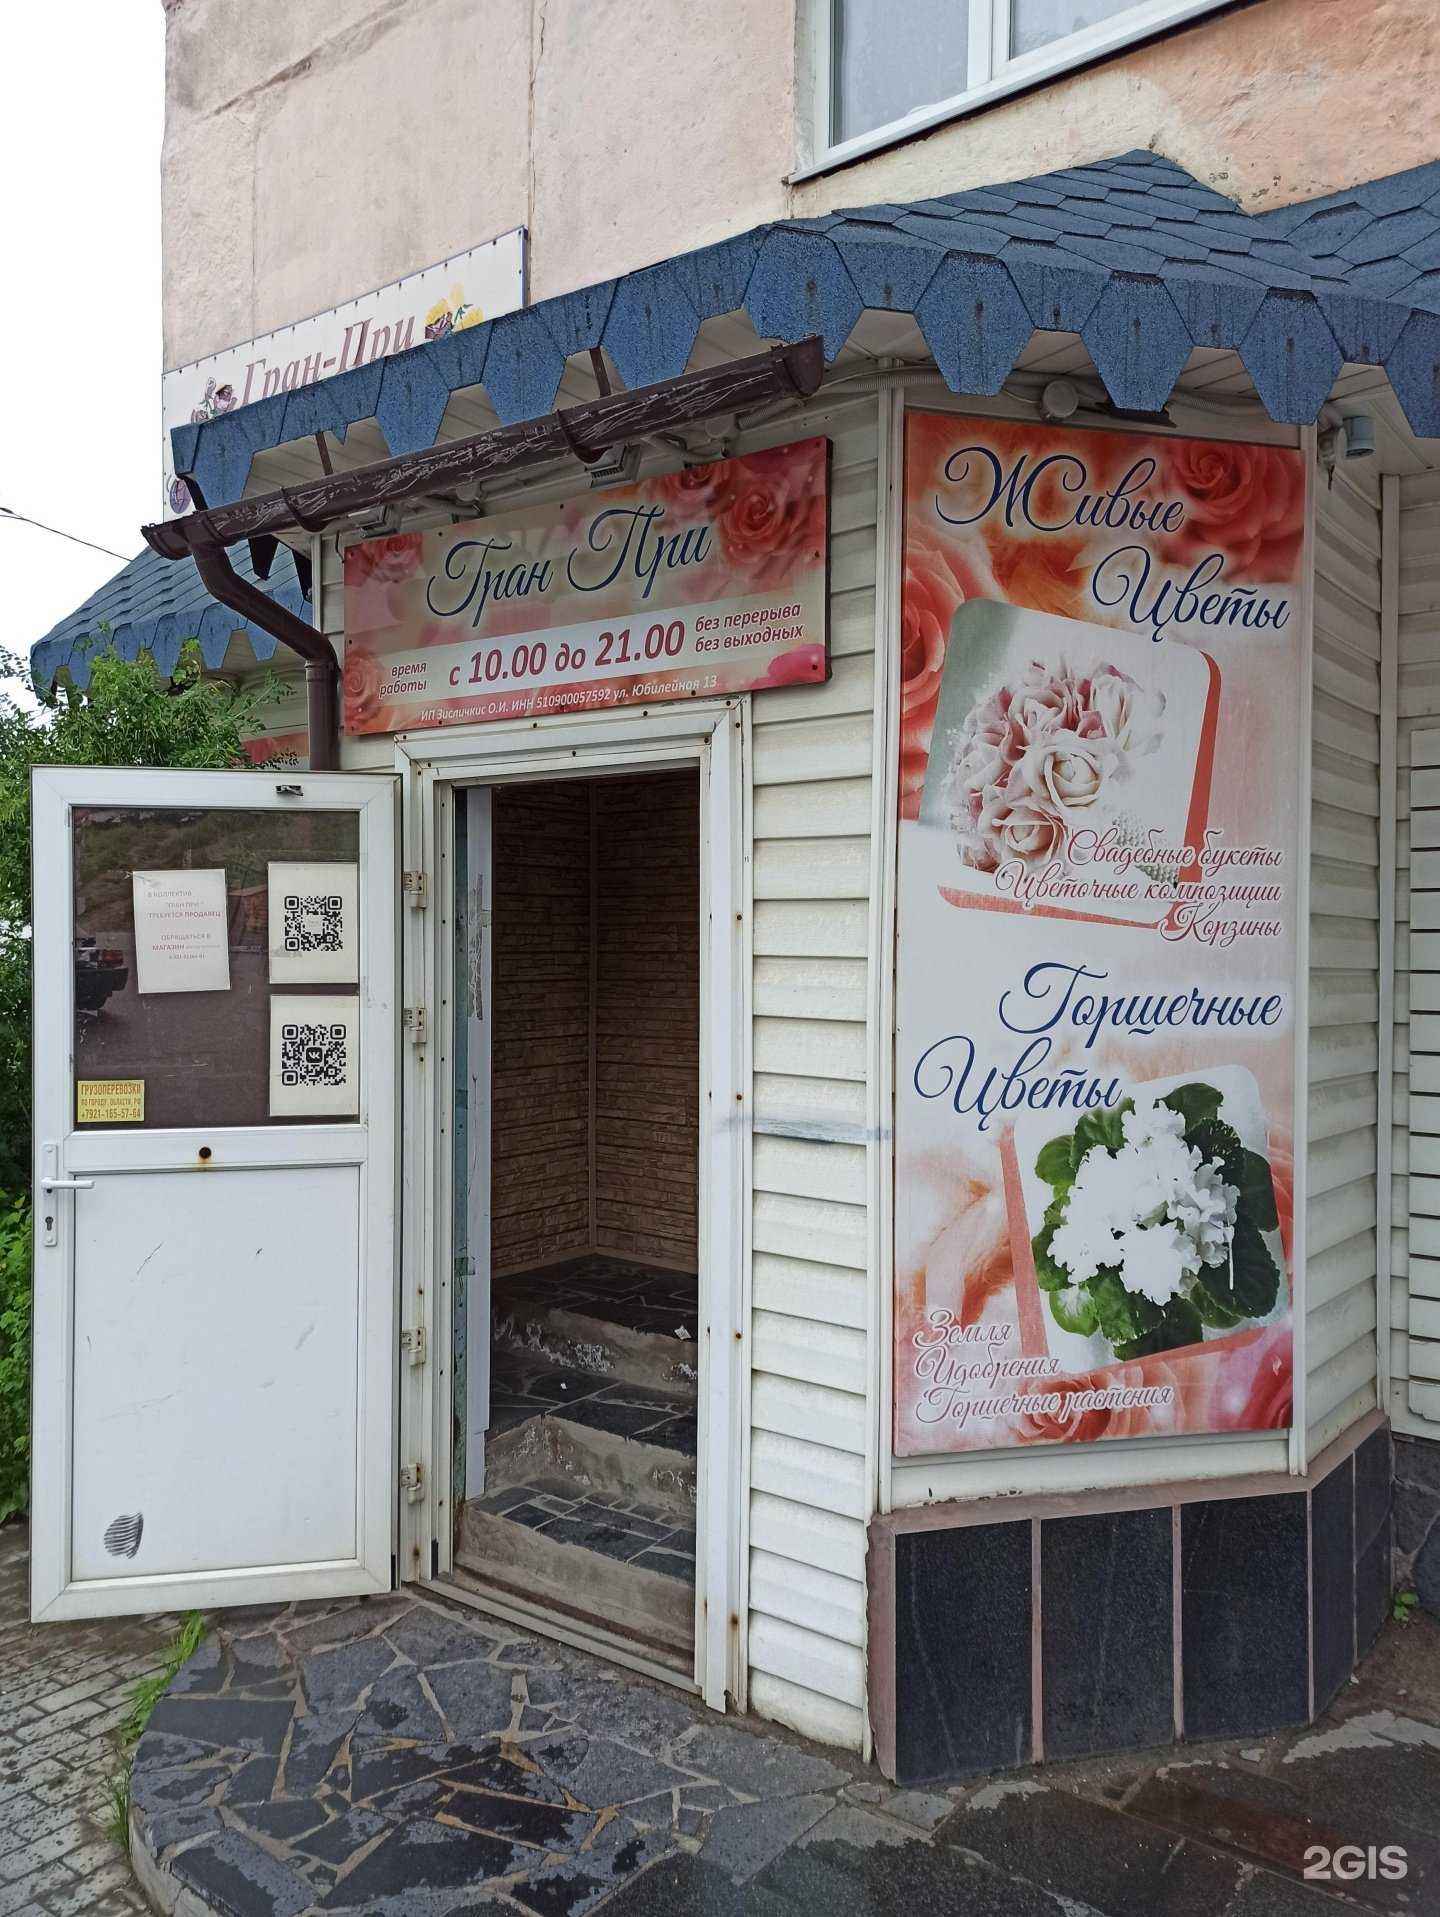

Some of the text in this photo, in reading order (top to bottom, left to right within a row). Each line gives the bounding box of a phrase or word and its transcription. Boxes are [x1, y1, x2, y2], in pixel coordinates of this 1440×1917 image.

[242, 316, 416, 405] Гран-При
[935, 446, 1185, 532] Живые
[427, 504, 712, 628] Гран При
[1092, 545, 1290, 642] Цветы
[695, 603, 801, 633] без перерыва
[695, 625, 804, 652] без выходных
[391, 661, 427, 678] время
[468, 642, 547, 683] 10.00
[554, 643, 586, 672] до
[595, 620, 685, 666] 21.00
[378, 679, 427, 699] работы
[511, 700, 534, 711] ИНН
[536, 689, 611, 708] 510900057592
[632, 678, 700, 696] Юбилейная
[1067, 827, 1282, 877] Свадебные букеты
[995, 861, 1282, 908] Цветочные композиции
[1160, 901, 1282, 947] Корзины
[998, 962, 1283, 1048] Горшечные
[914, 1035, 1122, 1131] Цветы
[914, 1309, 1011, 1347] Земля
[915, 1343, 1059, 1389] Удобрения
[916, 1386, 1173, 1428] Горшечные растения
